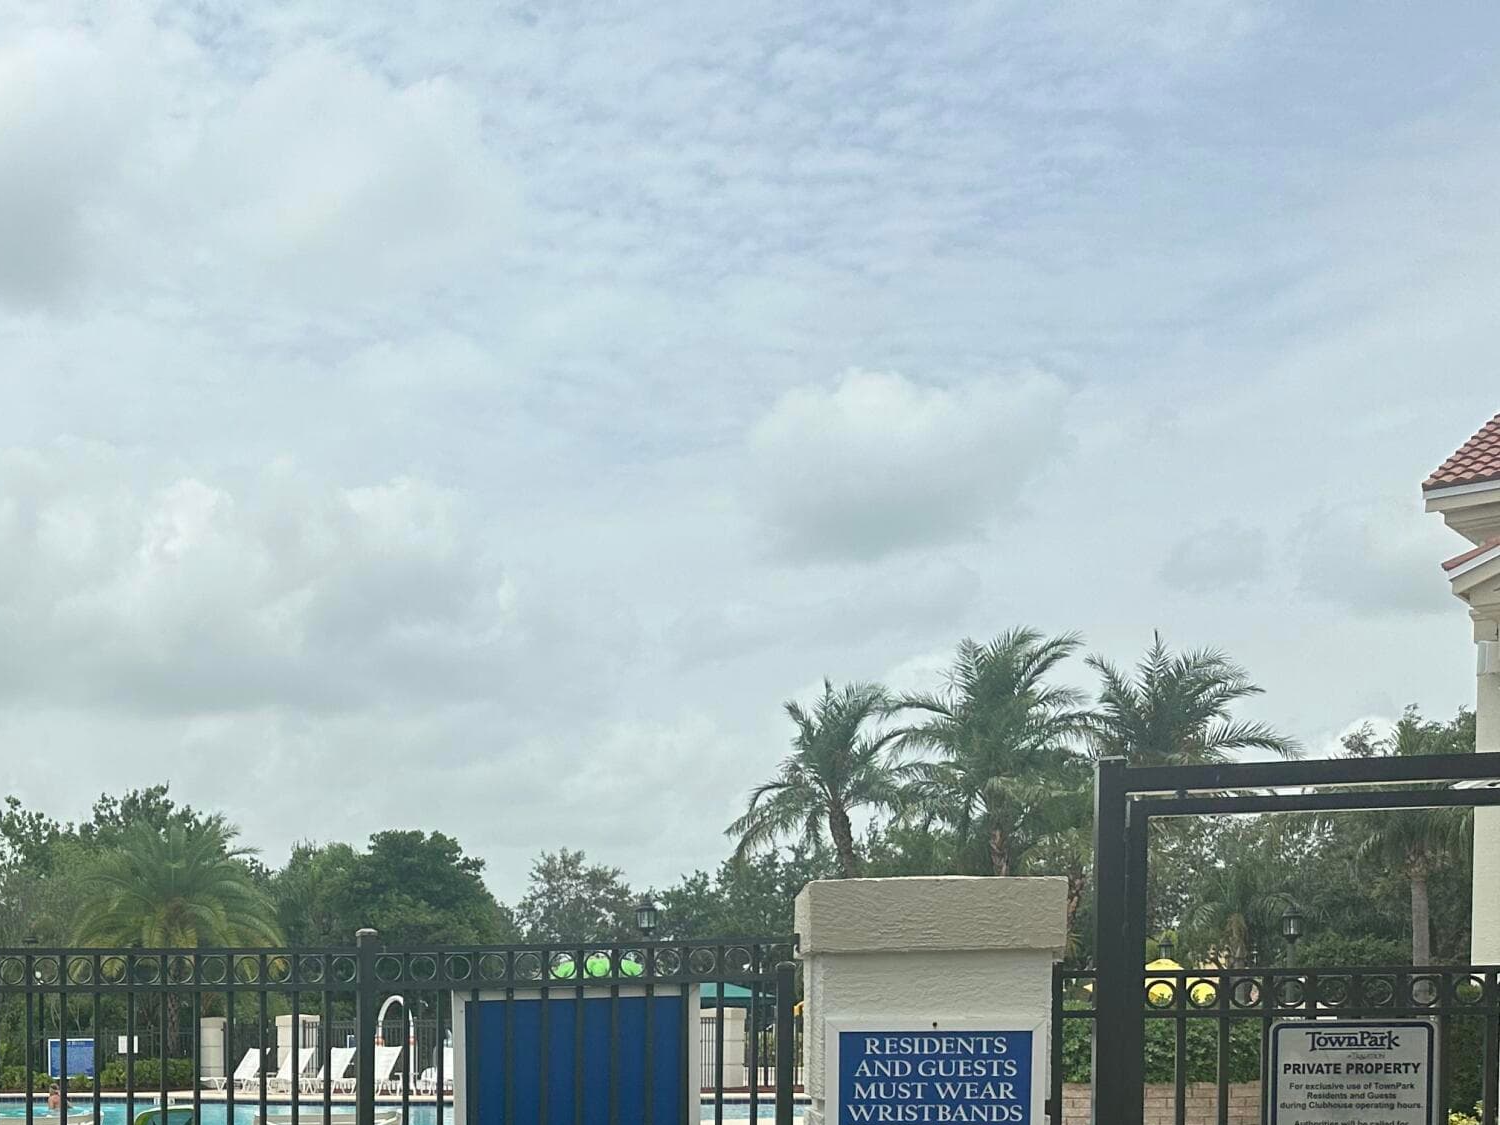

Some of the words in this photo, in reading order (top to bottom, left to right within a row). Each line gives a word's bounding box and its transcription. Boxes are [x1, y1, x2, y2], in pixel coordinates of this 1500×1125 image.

[865, 1036, 1007, 1055] RESIDENTS
[1305, 1031, 1400, 1051] TownPark
[854, 1060, 912, 1077] AND
[918, 1059, 1017, 1077] GUESTS
[1283, 1063, 1341, 1074] PRIVATE
[1346, 1063, 1421, 1074] PROPERTY
[853, 1082, 928, 1099] MUST
[934, 1082, 1017, 1099] WEAR
[847, 1104, 1023, 1122] WRISTBANDS
[1280, 1102, 1306, 1110] during
[1355, 1102, 1395, 1110] operating
